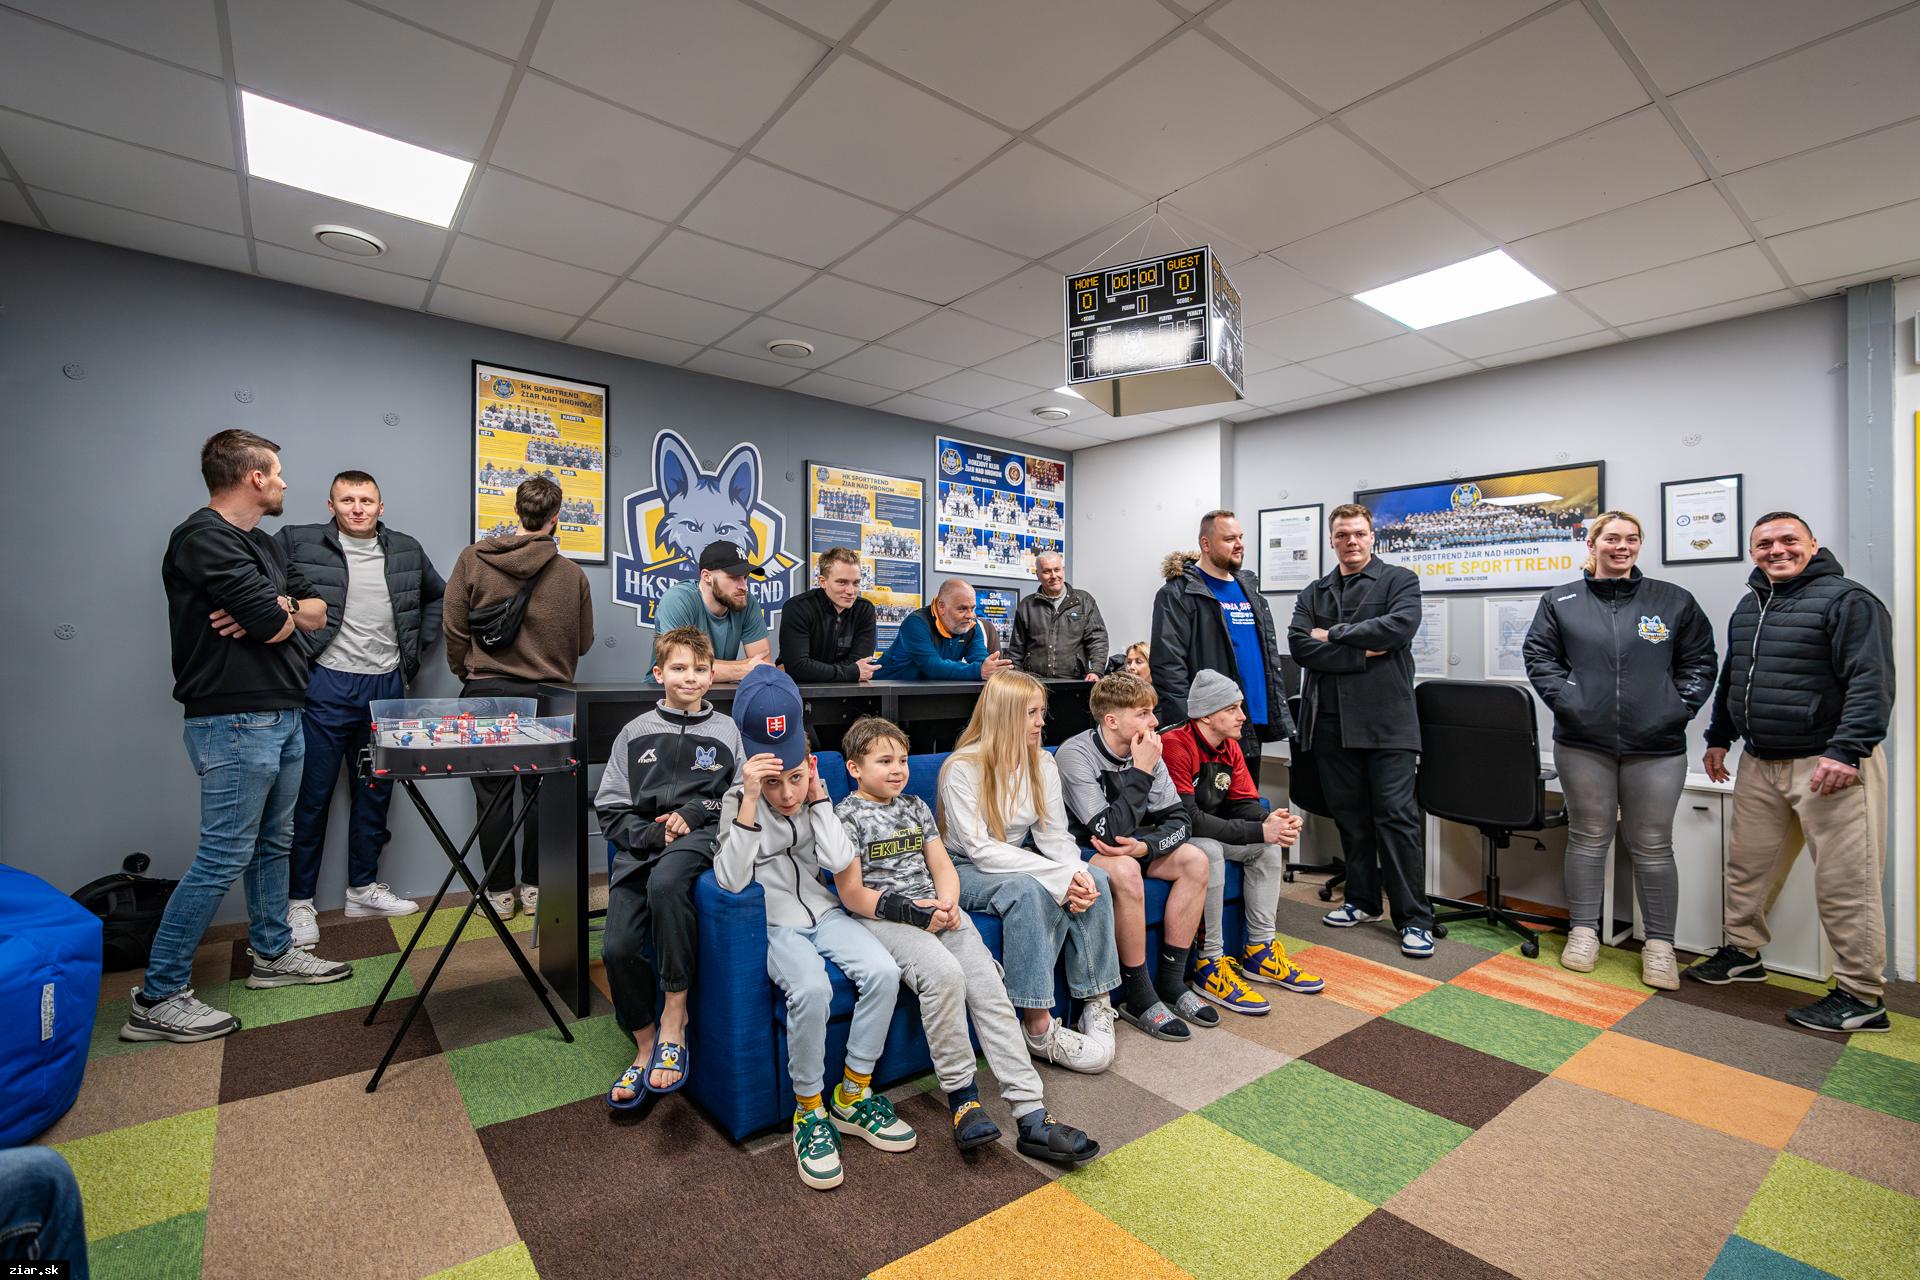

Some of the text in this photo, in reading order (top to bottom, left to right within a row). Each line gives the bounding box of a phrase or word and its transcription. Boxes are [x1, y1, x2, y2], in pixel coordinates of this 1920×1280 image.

[1167, 255, 1200, 270] GUEST
[1075, 276, 1099, 290] HOME
[1113, 269, 1156, 289] 00:00
[1179, 273, 1190, 291] 0
[1082, 293, 1093, 309] 0
[1158, 314, 1173, 322] PLAYER
[1186, 309, 1203, 317] PENALTY
[520, 383, 532, 391] HK
[541, 395, 557, 403] NAD
[559, 397, 592, 409] HRONOM
[851, 475, 889, 486] SPORTTREND
[856, 482, 869, 490] NAD
[869, 484, 895, 493] HRONOM
[1412, 552, 1462, 562] SPORTTREND
[1463, 550, 1482, 559] ŽIAR
[1484, 549, 1501, 557] NAD
[1503, 547, 1539, 557] HRONOM
[1426, 562, 1456, 576] SME
[1461, 555, 1572, 575] SPORTTREND
[980, 598, 999, 606] JEDEN
[871, 836, 923, 858] SKILLS
